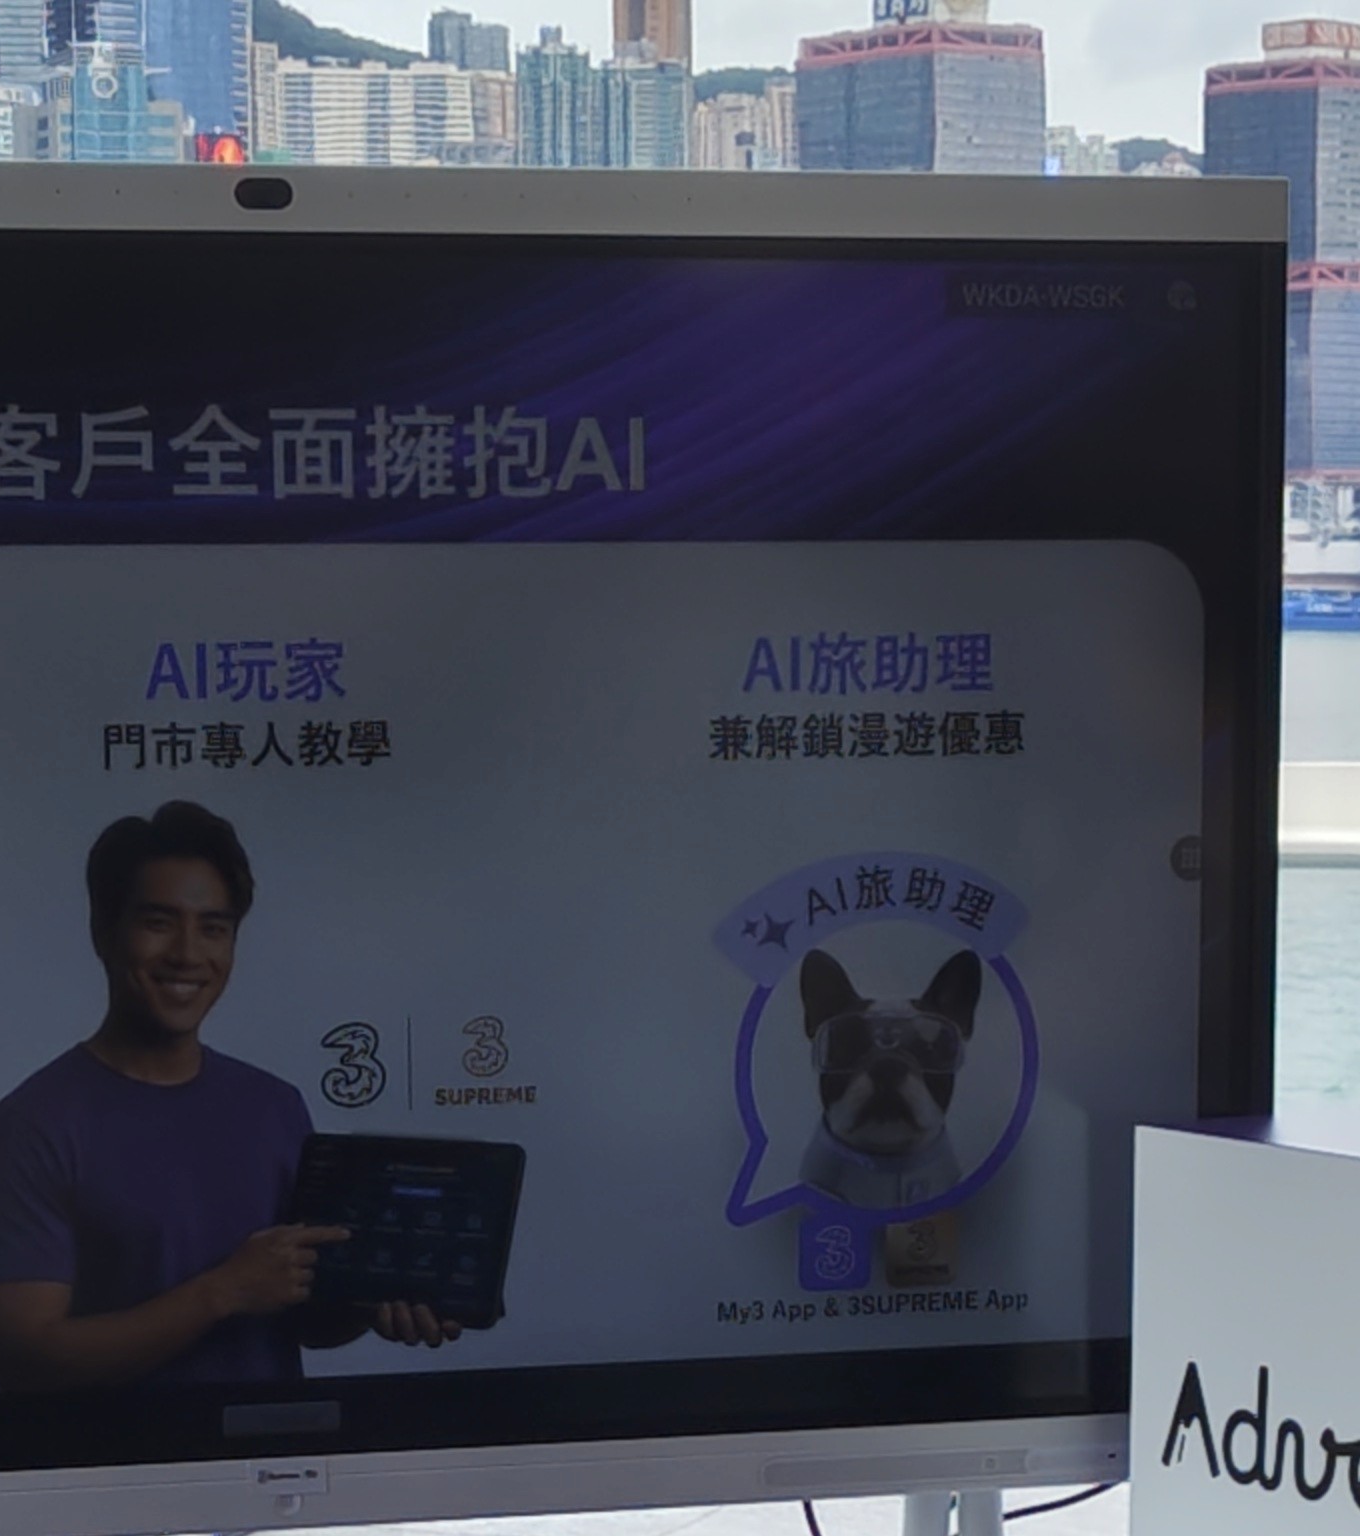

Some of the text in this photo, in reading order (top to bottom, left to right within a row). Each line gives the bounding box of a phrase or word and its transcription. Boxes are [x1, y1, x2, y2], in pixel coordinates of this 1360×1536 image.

[145, 637, 347, 703] AI玩家
[742, 631, 995, 696] AI旅助理
[102, 720, 391, 772] 門市專人教學
[709, 709, 1026, 761] 兼解鎖漫遊優惠
[805, 864, 996, 932] AI旅助理
[435, 1085, 537, 1107] SUPREME
[717, 1289, 1029, 1325] My3 App & 3SUPREME App
